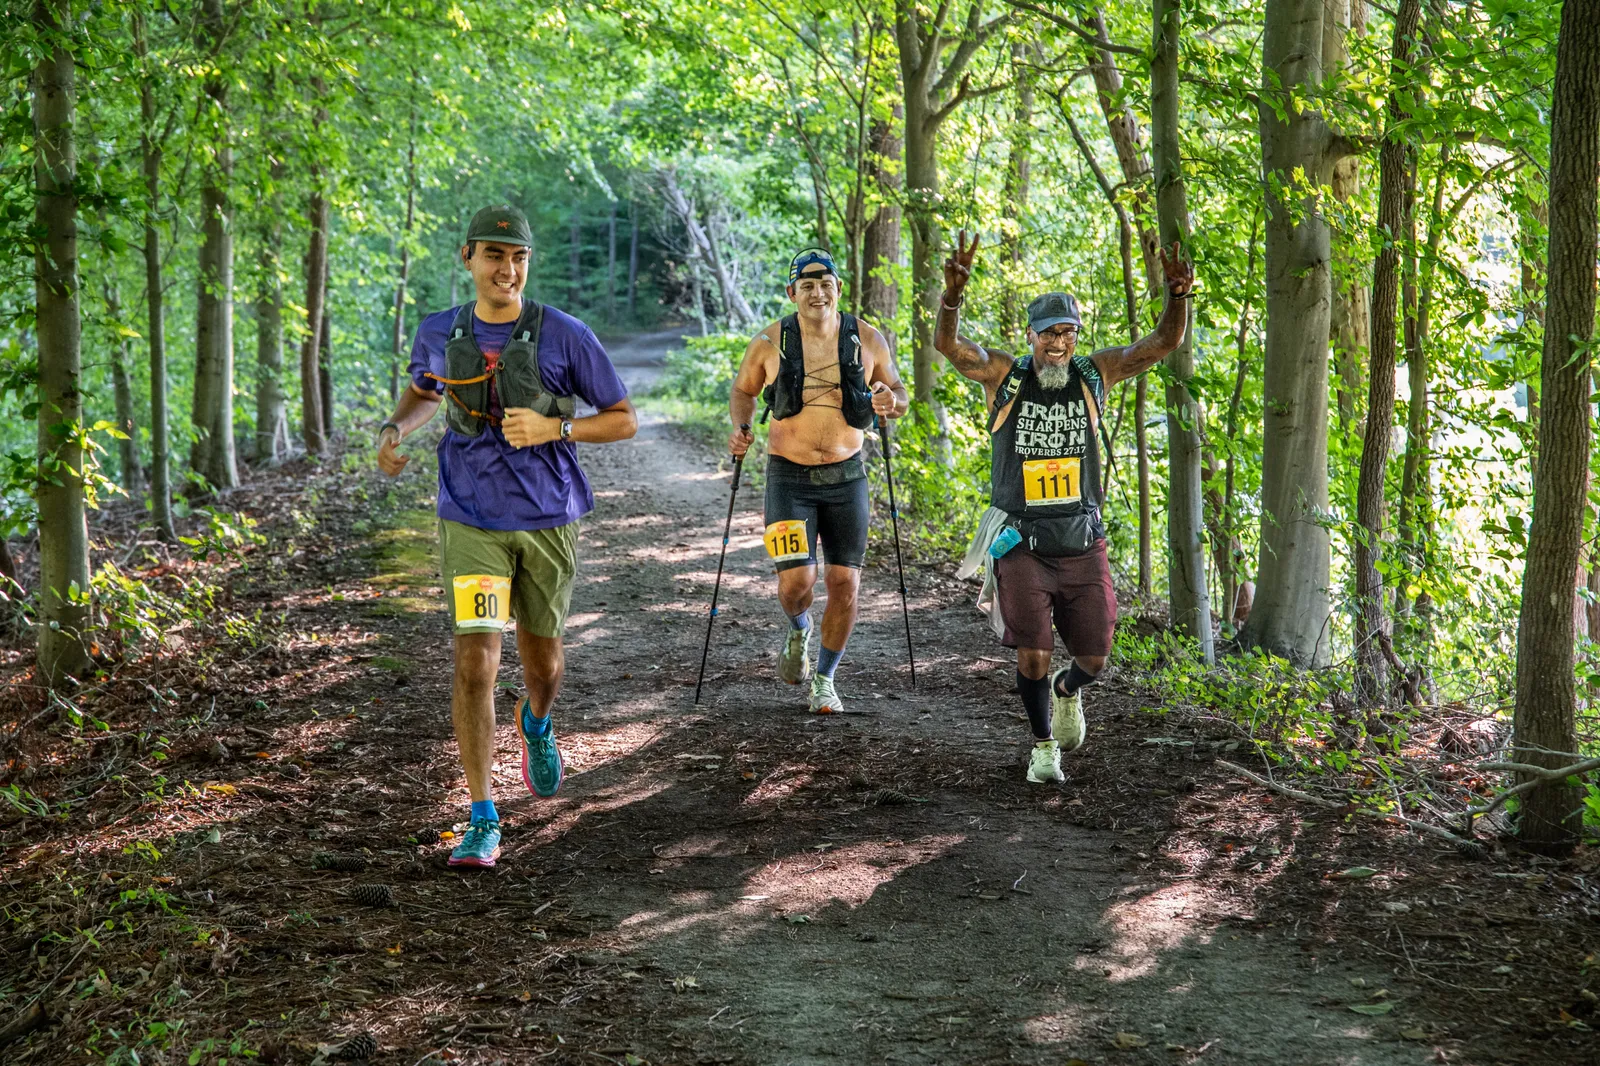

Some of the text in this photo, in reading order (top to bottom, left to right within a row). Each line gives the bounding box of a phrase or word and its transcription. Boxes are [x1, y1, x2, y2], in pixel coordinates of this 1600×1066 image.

[1019, 400, 1085, 421] IRON
[1017, 417, 1087, 432] SHARPENS
[1015, 430, 1085, 448] IRON
[1064, 446, 1086, 456] 27:17
[1037, 474, 1071, 498] 111
[771, 534, 799, 556] 115
[474, 593, 497, 619] 80
